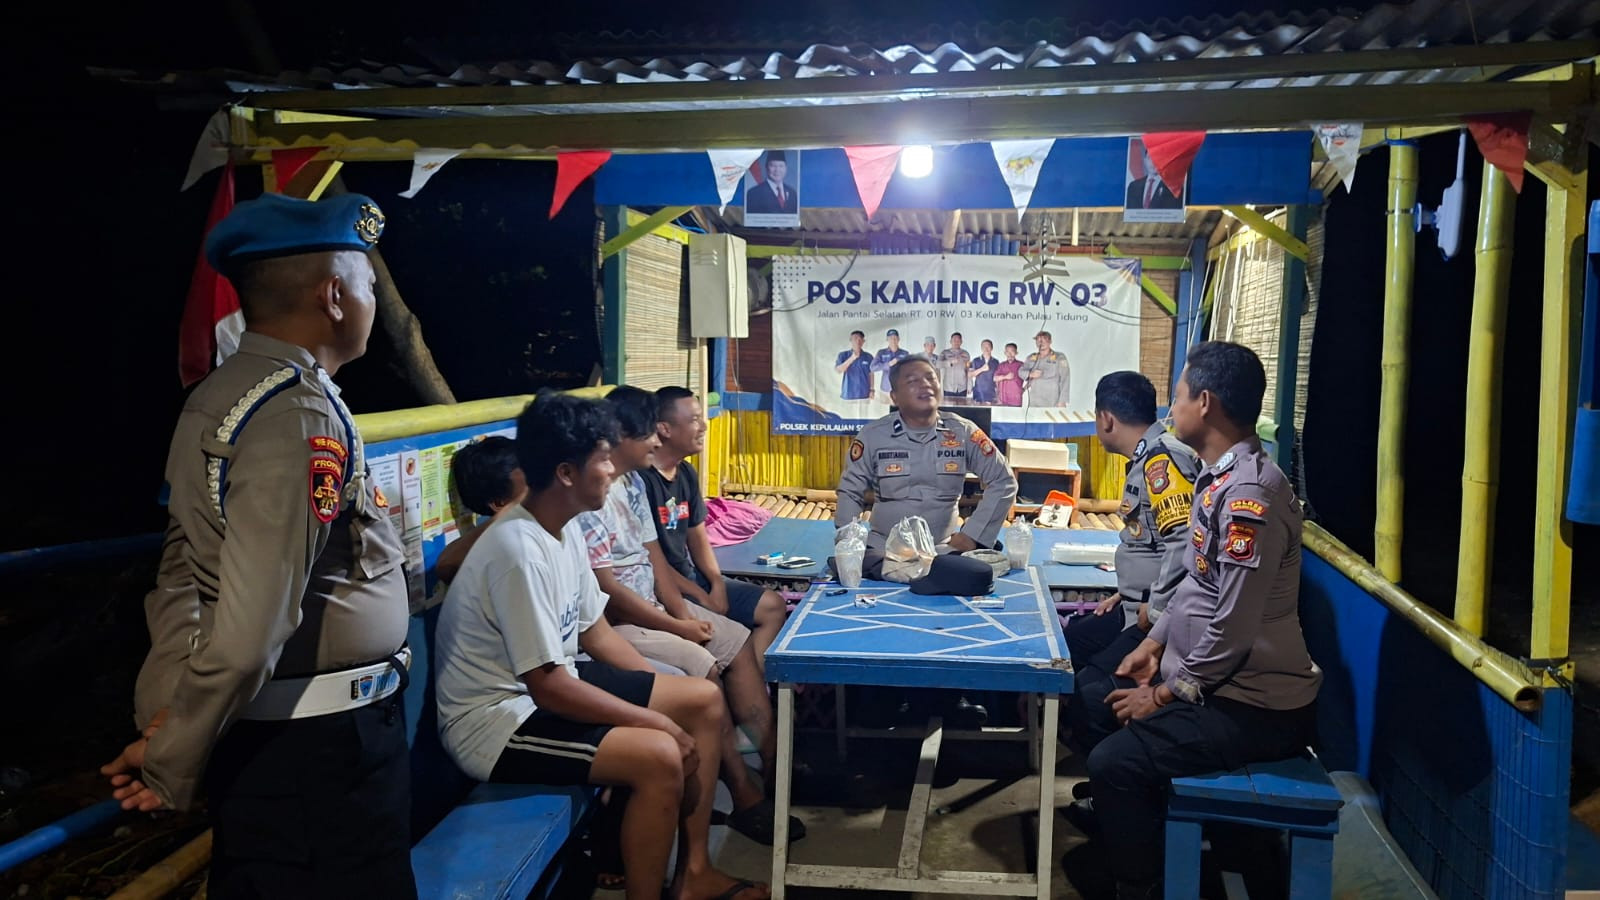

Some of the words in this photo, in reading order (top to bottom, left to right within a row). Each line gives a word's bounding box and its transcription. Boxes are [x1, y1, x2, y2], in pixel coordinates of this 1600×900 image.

[807, 280, 861, 304] POS
[871, 280, 999, 304] KAMLING
[1009, 281, 1060, 306] RW.
[1070, 282, 1108, 307] 03
[818, 310, 840, 319] Jalan
[843, 310, 870, 319] Pantai
[874, 310, 907, 319] Selatan
[926, 310, 937, 319] 01
[960, 310, 973, 318] 03
[976, 311, 1023, 320] Kelurahan
[1026, 311, 1051, 321] Pulau
[1056, 313, 1089, 322] Tidung
[780, 423, 809, 431] POLSEK
[810, 423, 854, 432] KEPULAUAN
[937, 449, 965, 458] POLRI
